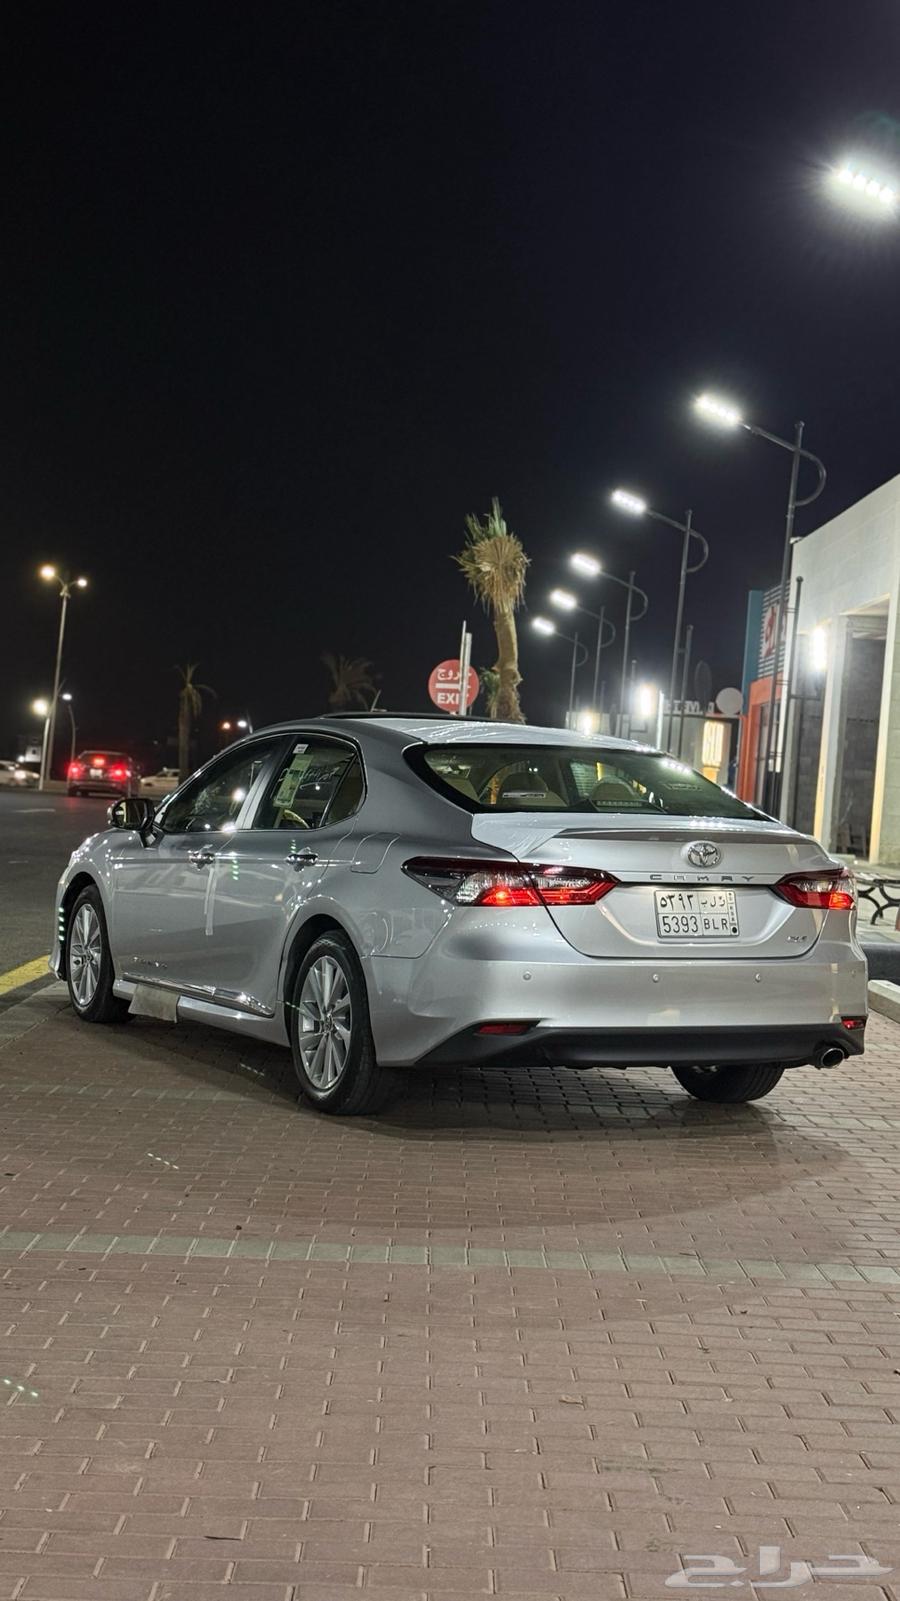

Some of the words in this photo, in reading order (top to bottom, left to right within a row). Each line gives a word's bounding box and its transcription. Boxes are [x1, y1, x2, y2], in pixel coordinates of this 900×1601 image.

[437, 668, 472, 681] روج
[437, 693, 470, 704] EXI
[662, 915, 699, 933] 5393
[703, 918, 728, 930] BLR
